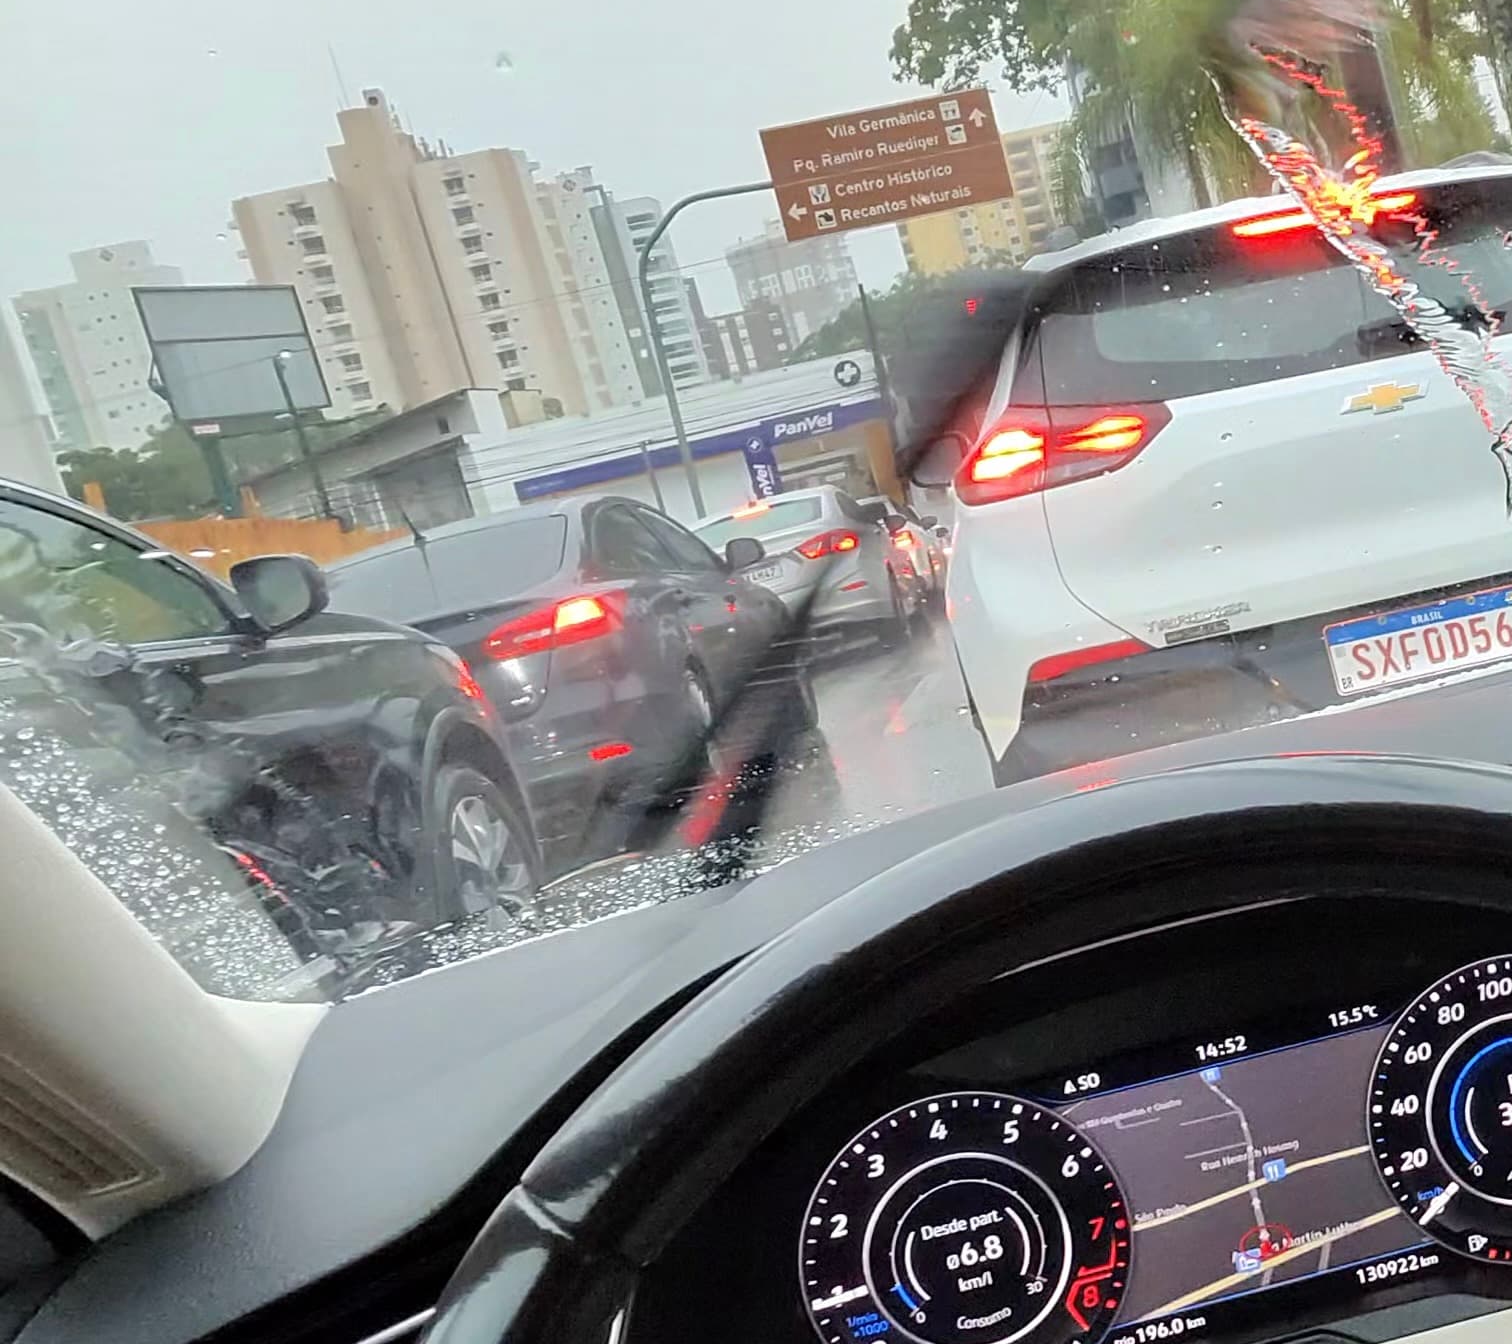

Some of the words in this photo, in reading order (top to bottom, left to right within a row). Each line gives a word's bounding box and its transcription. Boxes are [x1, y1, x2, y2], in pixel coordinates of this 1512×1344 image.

[826, 121, 856, 140] Vila
[859, 107, 936, 133] Germânica
[793, 158, 819, 174] Pq.
[821, 148, 875, 167] Ramiro
[878, 135, 940, 159] Ruediger
[834, 178, 885, 198] Centro
[887, 164, 953, 188] Histórico
[841, 202, 908, 222] Recantos
[910, 185, 972, 208] Naturais
[1411, 611, 1444, 625] BRASIL
[1341, 676, 1354, 690] BR
[1476, 977, 1512, 1001] 100
[1437, 1003, 1465, 1025] 80
[1195, 1035, 1248, 1061] 14:52
[1404, 1042, 1432, 1064] 60
[1390, 1094, 1419, 1117] 40
[929, 1119, 949, 1140] 4
[1002, 1122, 1020, 1144] 5
[867, 1154, 885, 1179] 3
[1061, 1154, 1080, 1178] 6
[1400, 1147, 1428, 1172] 20
[1473, 1166, 1483, 1177] 0
[829, 1213, 848, 1239] 2
[920, 1218, 968, 1241] Desde
[969, 1209, 1004, 1232] part.
[1088, 1217, 1105, 1240] 7
[1357, 1254, 1419, 1285] 130922
[1420, 1252, 1439, 1267] km
[957, 1270, 994, 1293] km/l
[1025, 1281, 1044, 1296] 30
[1082, 1284, 1099, 1308] 8
[914, 1311, 927, 1324] 0
[956, 1306, 1013, 1330] Consumo
[1136, 1317, 1185, 1343] 196.0
[1186, 1315, 1206, 1331] km
